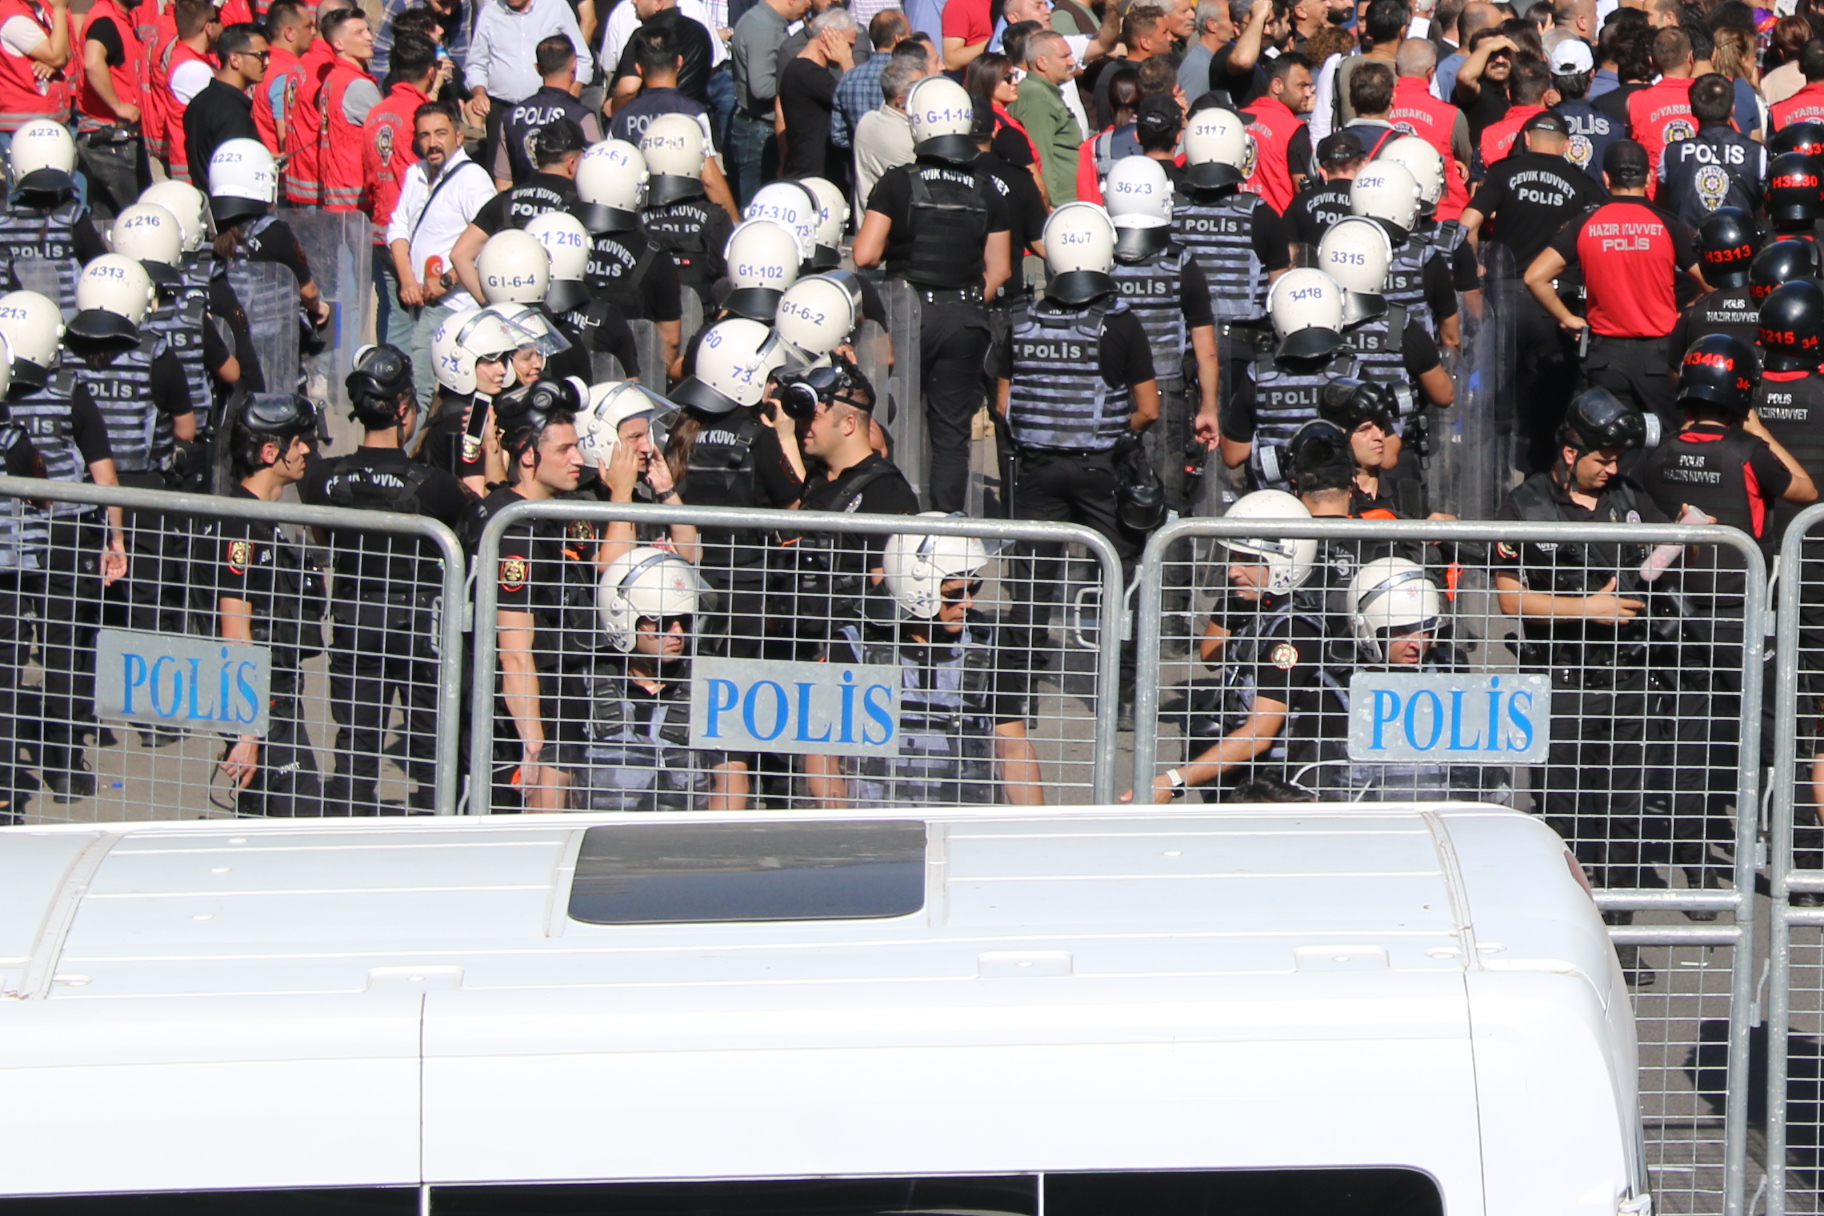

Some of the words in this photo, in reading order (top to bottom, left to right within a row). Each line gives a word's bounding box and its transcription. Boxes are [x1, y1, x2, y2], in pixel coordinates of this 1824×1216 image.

[1195, 125, 1227, 136] 3117
[1563, 113, 1610, 136] OLİS
[28, 128, 60, 138] 4221
[1681, 142, 1745, 165] POLİS
[1356, 177, 1385, 189] 3216
[1540, 171, 1576, 199] KUVVET
[124, 215, 160, 229] 4216
[1185, 217, 1238, 233] POLİS
[1589, 223, 1619, 237] HAZIR
[1622, 223, 1664, 237] KUVVET
[795, 225, 809, 237] 73
[10, 242, 64, 258] POLİS
[1603, 236, 1650, 252] POLİS
[1330, 251, 1365, 266] 3315
[1704, 244, 1752, 263] H3313
[89, 266, 125, 279] 4313
[739, 264, 783, 278] G1-102
[1289, 287, 1323, 302] 3418
[782, 301, 824, 325] G1-6-2
[1801, 335, 1818, 349] 34
[1023, 341, 1081, 360] POLİS
[731, 365, 752, 382] 73
[87, 380, 133, 398] OLİS
[1271, 386, 1318, 406] POLİ
[579, 434, 596, 450] 73
[120, 646, 259, 725] POLİS
[704, 670, 895, 746] POLİS
[1368, 675, 1535, 753] POLİS
